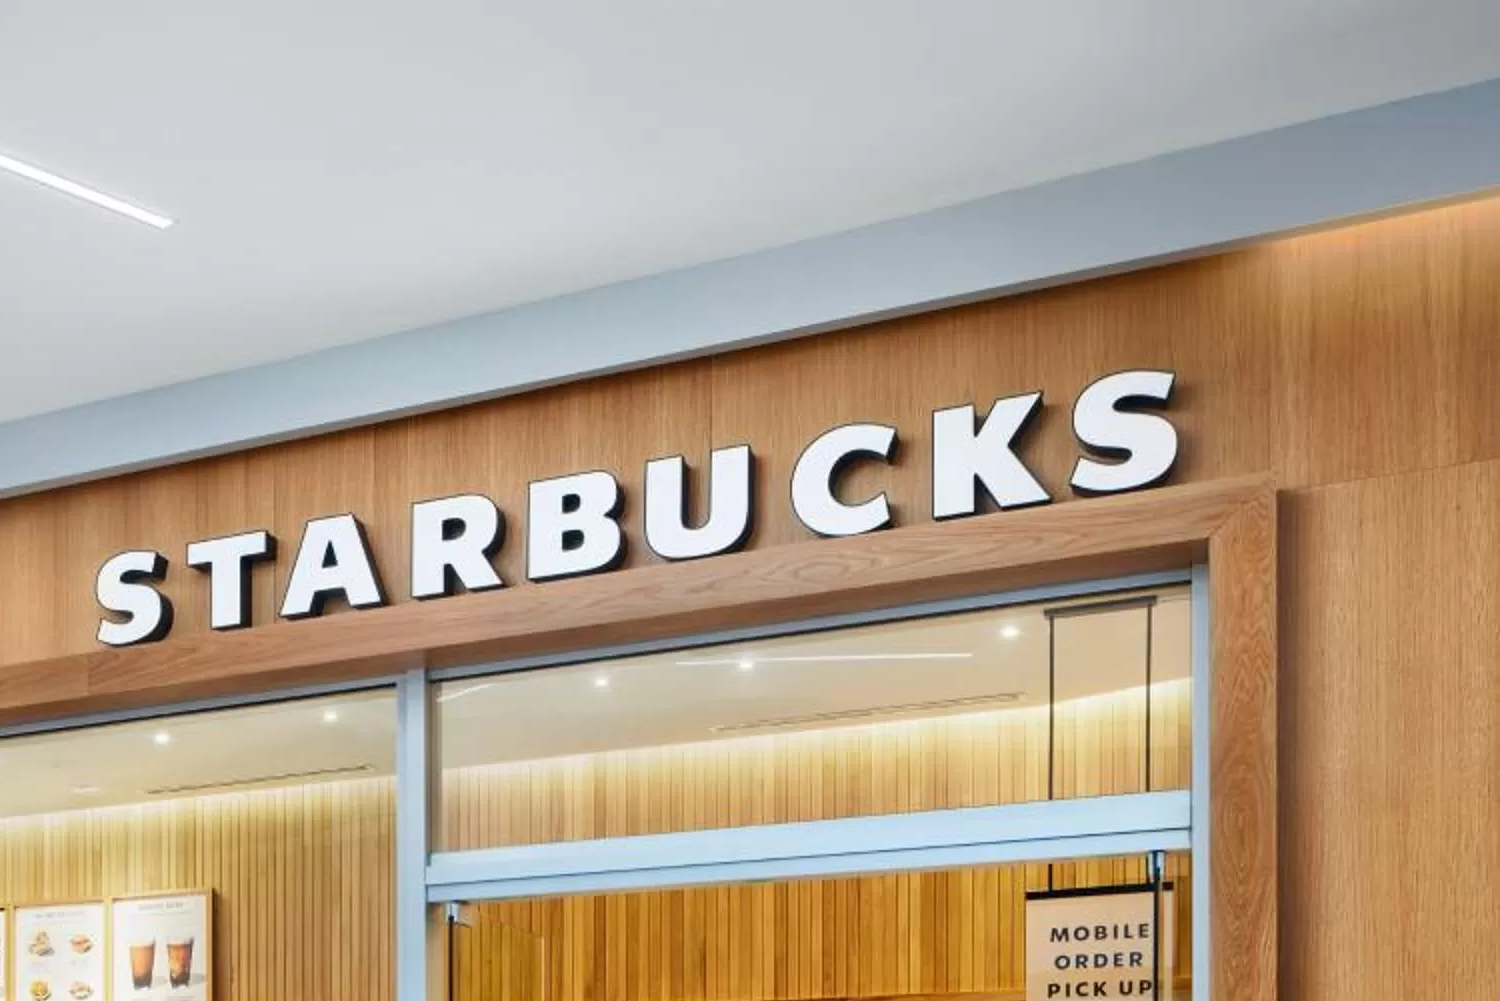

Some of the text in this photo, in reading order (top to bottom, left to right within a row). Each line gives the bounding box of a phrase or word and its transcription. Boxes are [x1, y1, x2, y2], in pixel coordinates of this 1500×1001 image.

[94, 369, 1180, 646] STARBUCKS
[1050, 923, 1150, 943] MOBILE
[1054, 951, 1143, 970] ORDER
[1047, 979, 1153, 999] PICK UP
